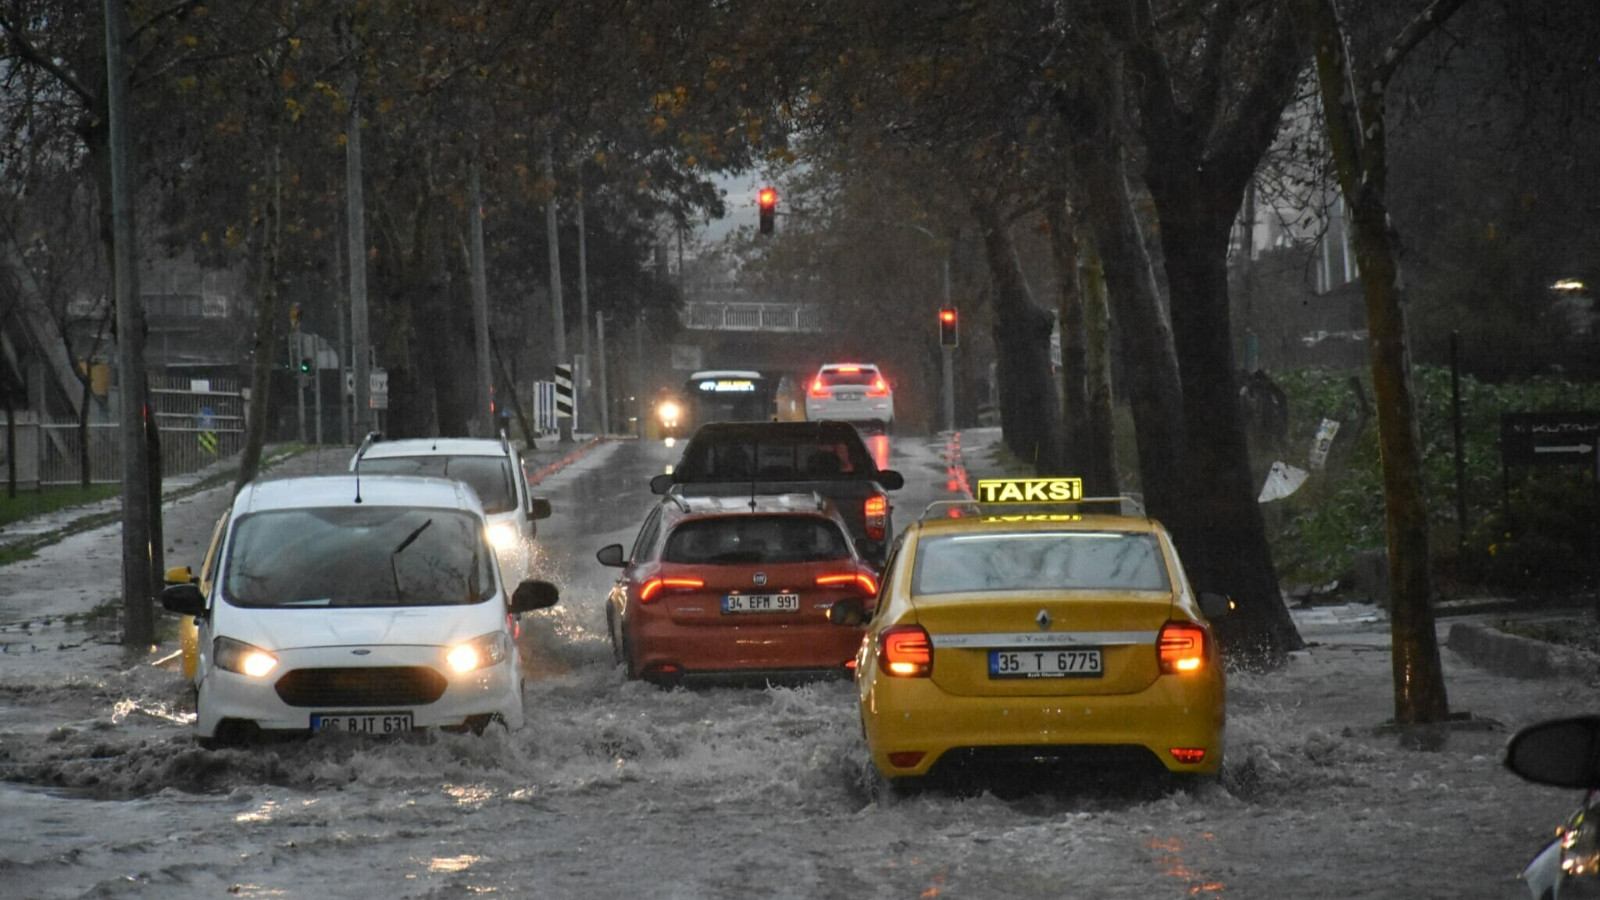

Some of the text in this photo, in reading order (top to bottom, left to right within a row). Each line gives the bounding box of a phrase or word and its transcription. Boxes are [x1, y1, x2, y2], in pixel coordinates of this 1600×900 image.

[729, 595, 797, 610] 34 EFM 991
[999, 652, 1099, 672] 35 T 6775
